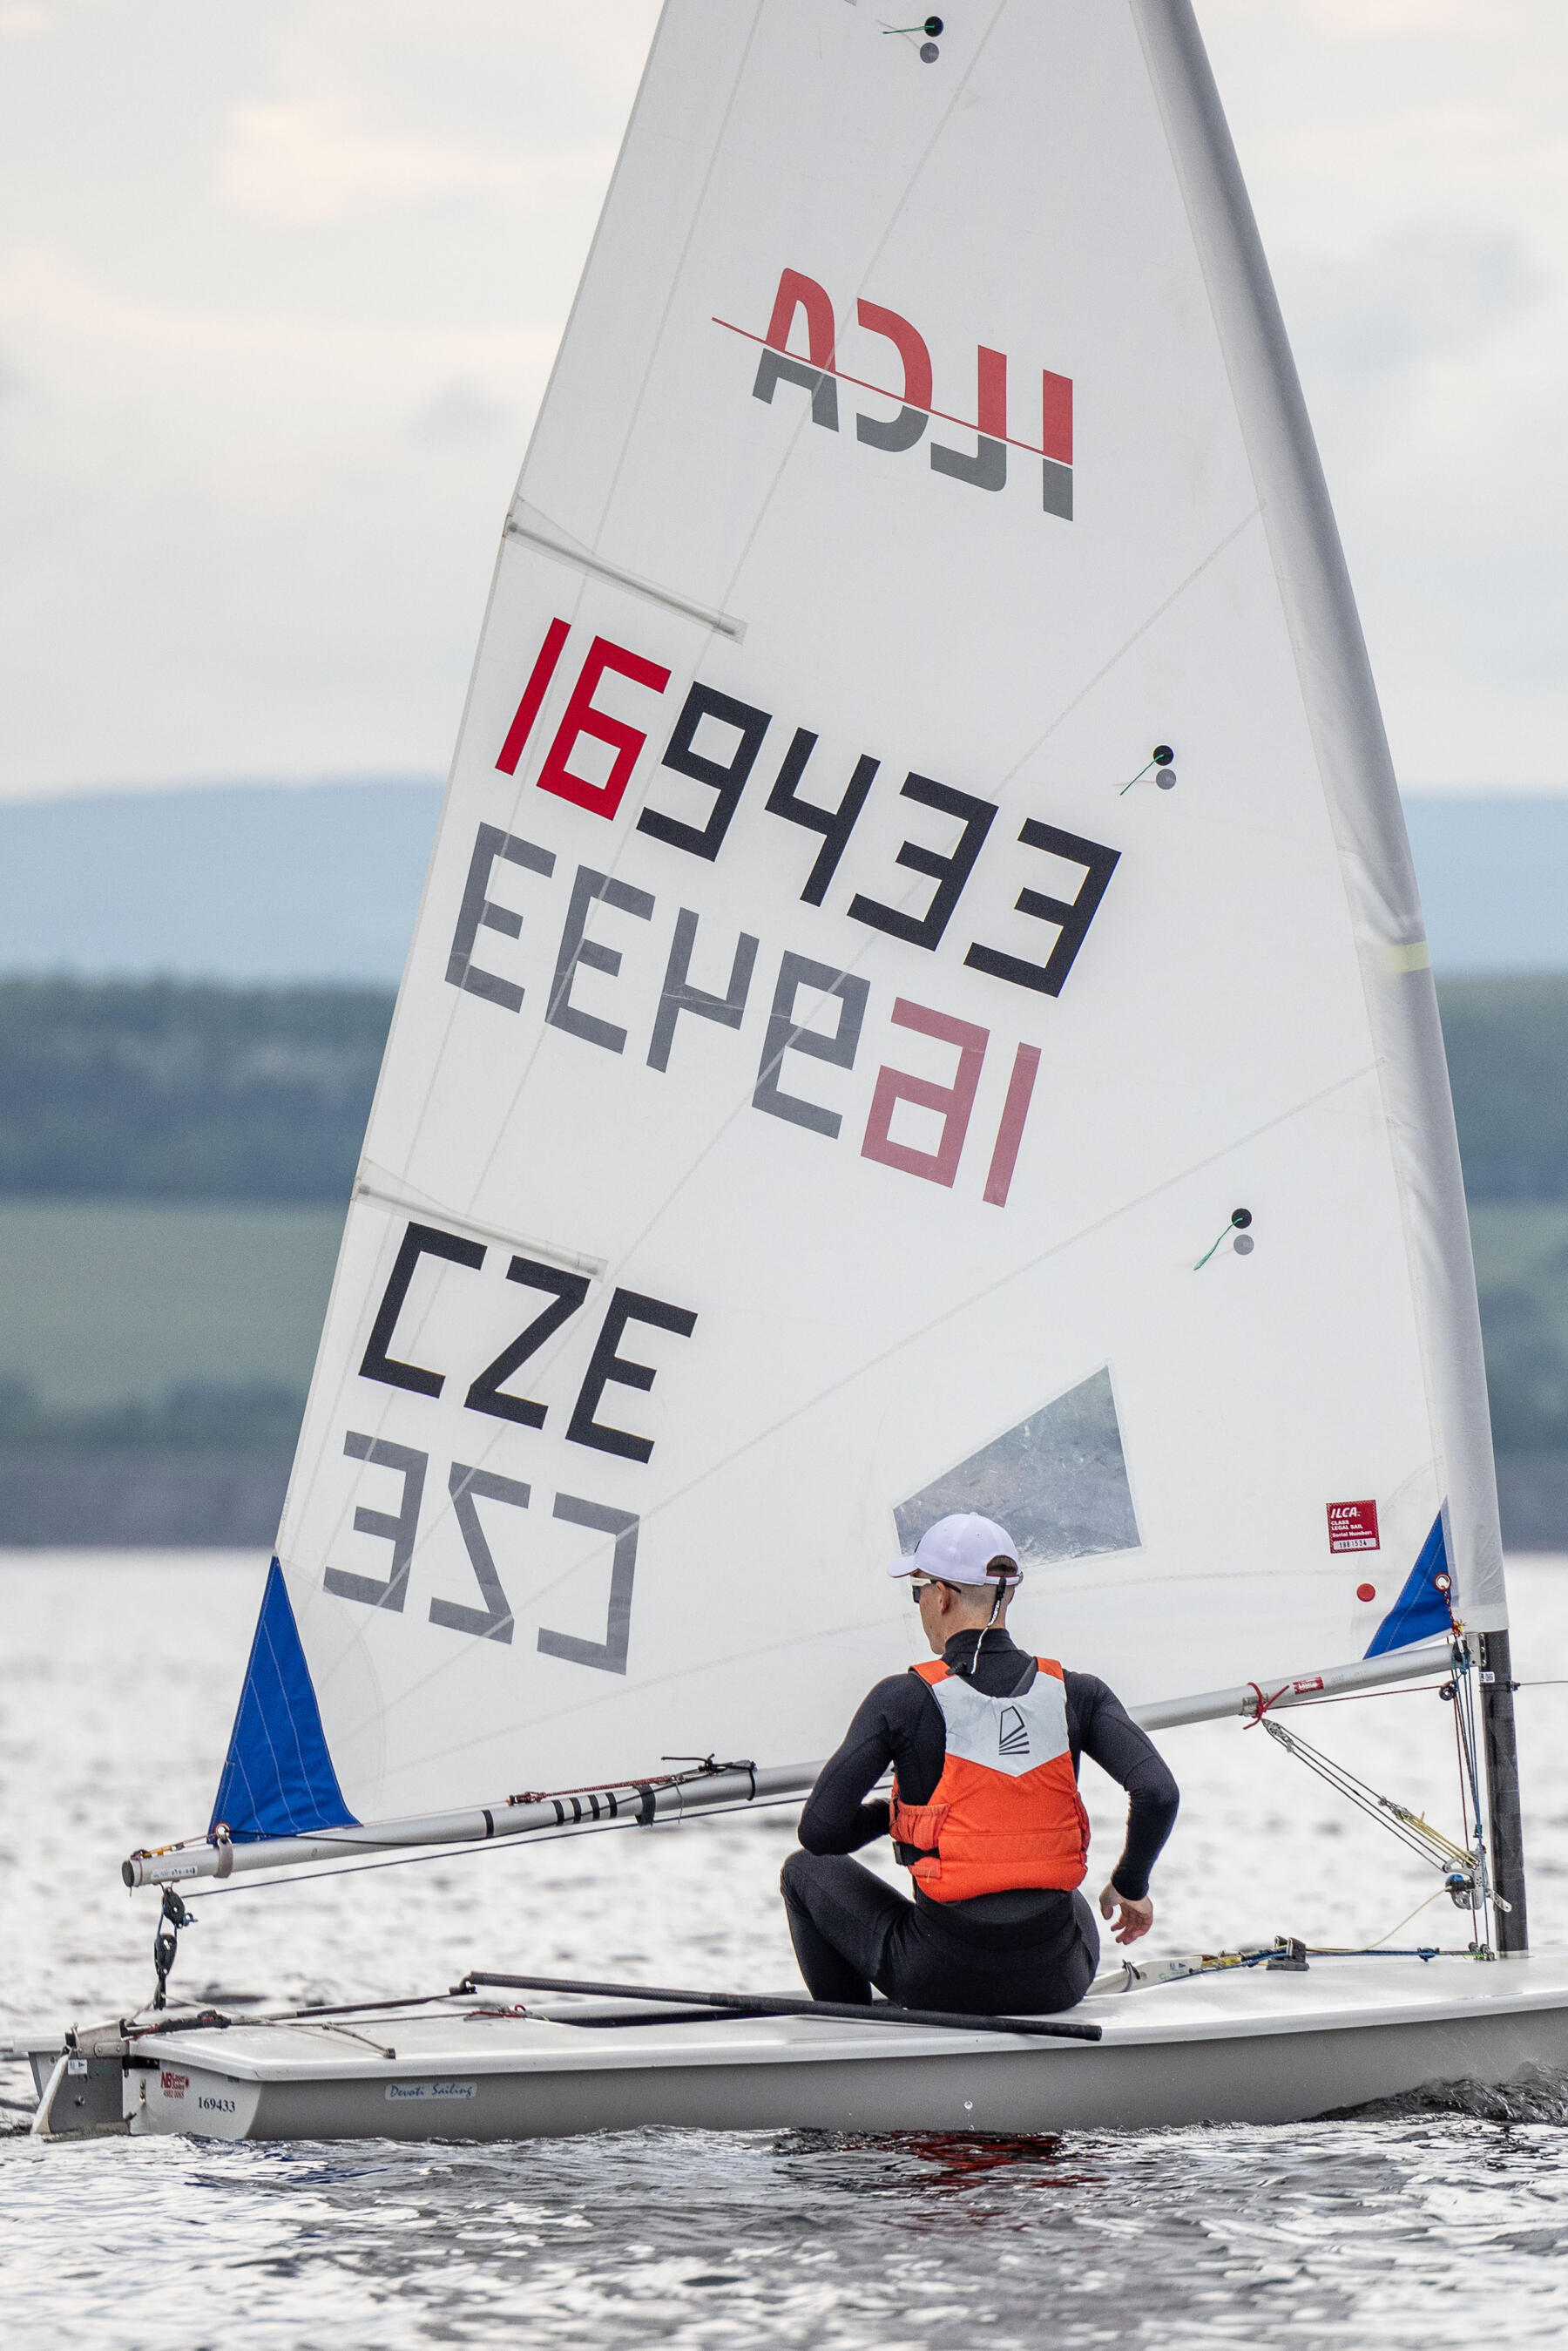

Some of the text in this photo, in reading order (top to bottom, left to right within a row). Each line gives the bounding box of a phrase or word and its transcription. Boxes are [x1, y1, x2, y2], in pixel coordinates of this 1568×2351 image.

[495, 617, 1122, 998] 169433
[358, 1221, 699, 1464] CZE
[1330, 1507, 1357, 1519] ILCA
[160, 2071, 172, 2089] NB
[431, 2083, 472, 2097] Sailing
[198, 2097, 235, 2112] 169433
